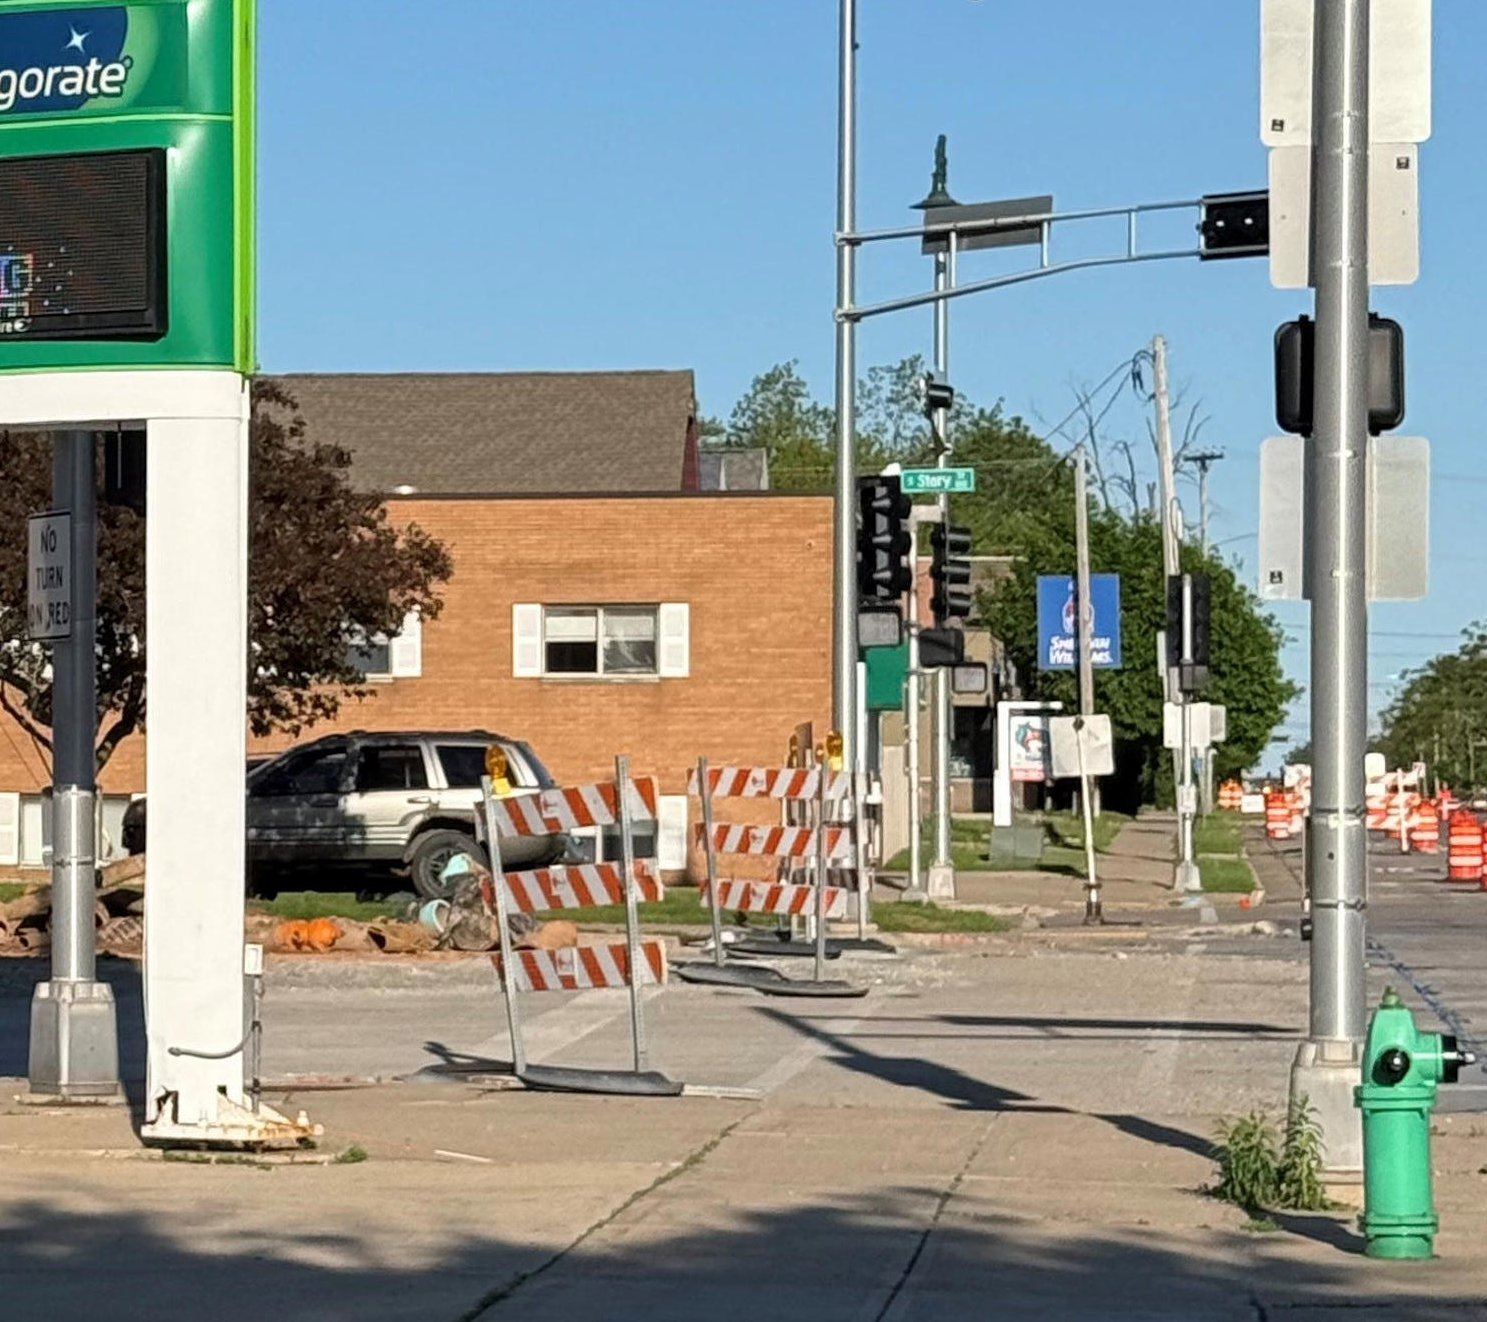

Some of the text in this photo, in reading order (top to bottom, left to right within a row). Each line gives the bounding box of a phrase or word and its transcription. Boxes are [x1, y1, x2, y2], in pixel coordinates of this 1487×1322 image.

[917, 474, 952, 489] Story
[40, 524, 57, 554] NO
[36, 566, 63, 590] TURN
[48, 601, 70, 627] RED
